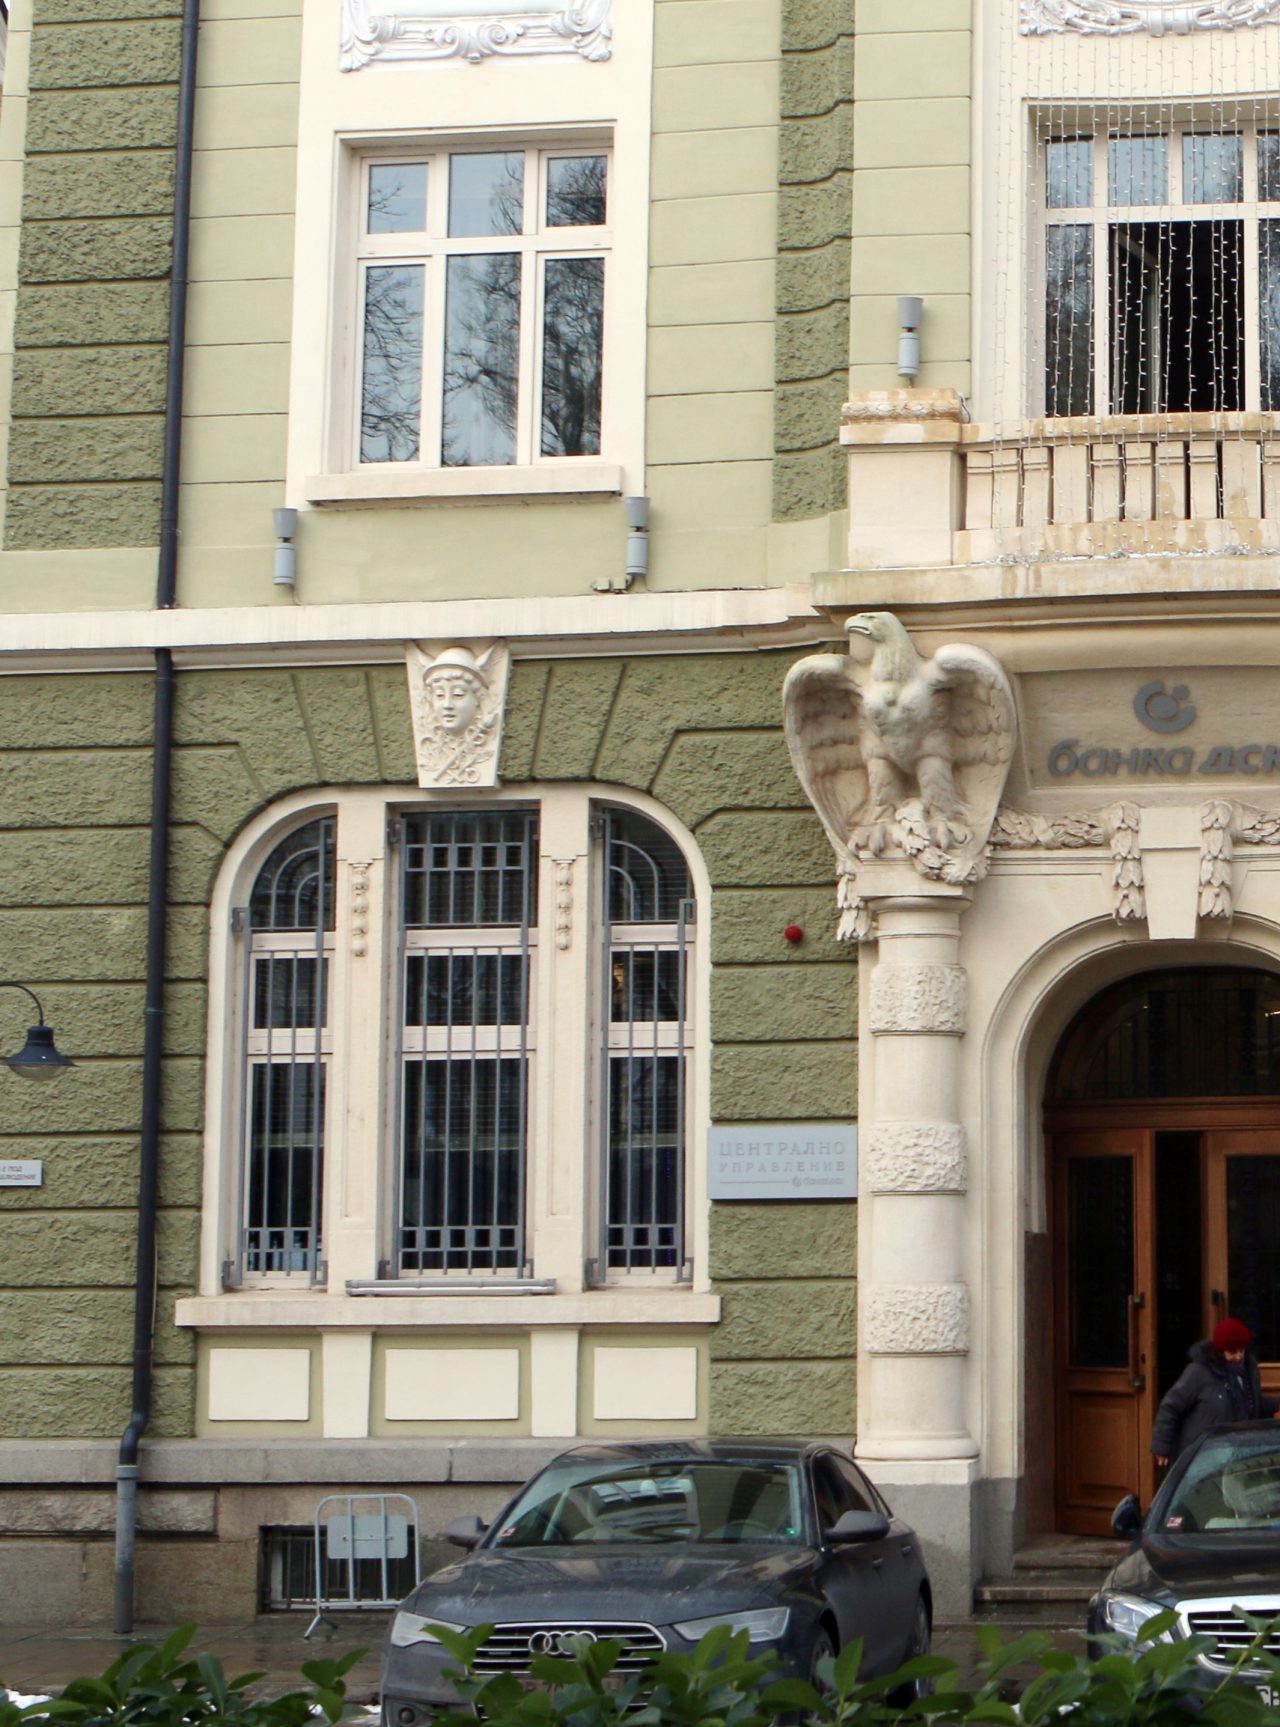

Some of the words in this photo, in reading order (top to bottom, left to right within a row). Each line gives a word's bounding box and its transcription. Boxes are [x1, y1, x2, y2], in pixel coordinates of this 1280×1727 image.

[1048, 738, 1194, 777] банка
[719, 1141, 846, 1157] ЦЕНТРАЛНО
[719, 1161, 846, 1173] УПРАВЛЕНИЕ
